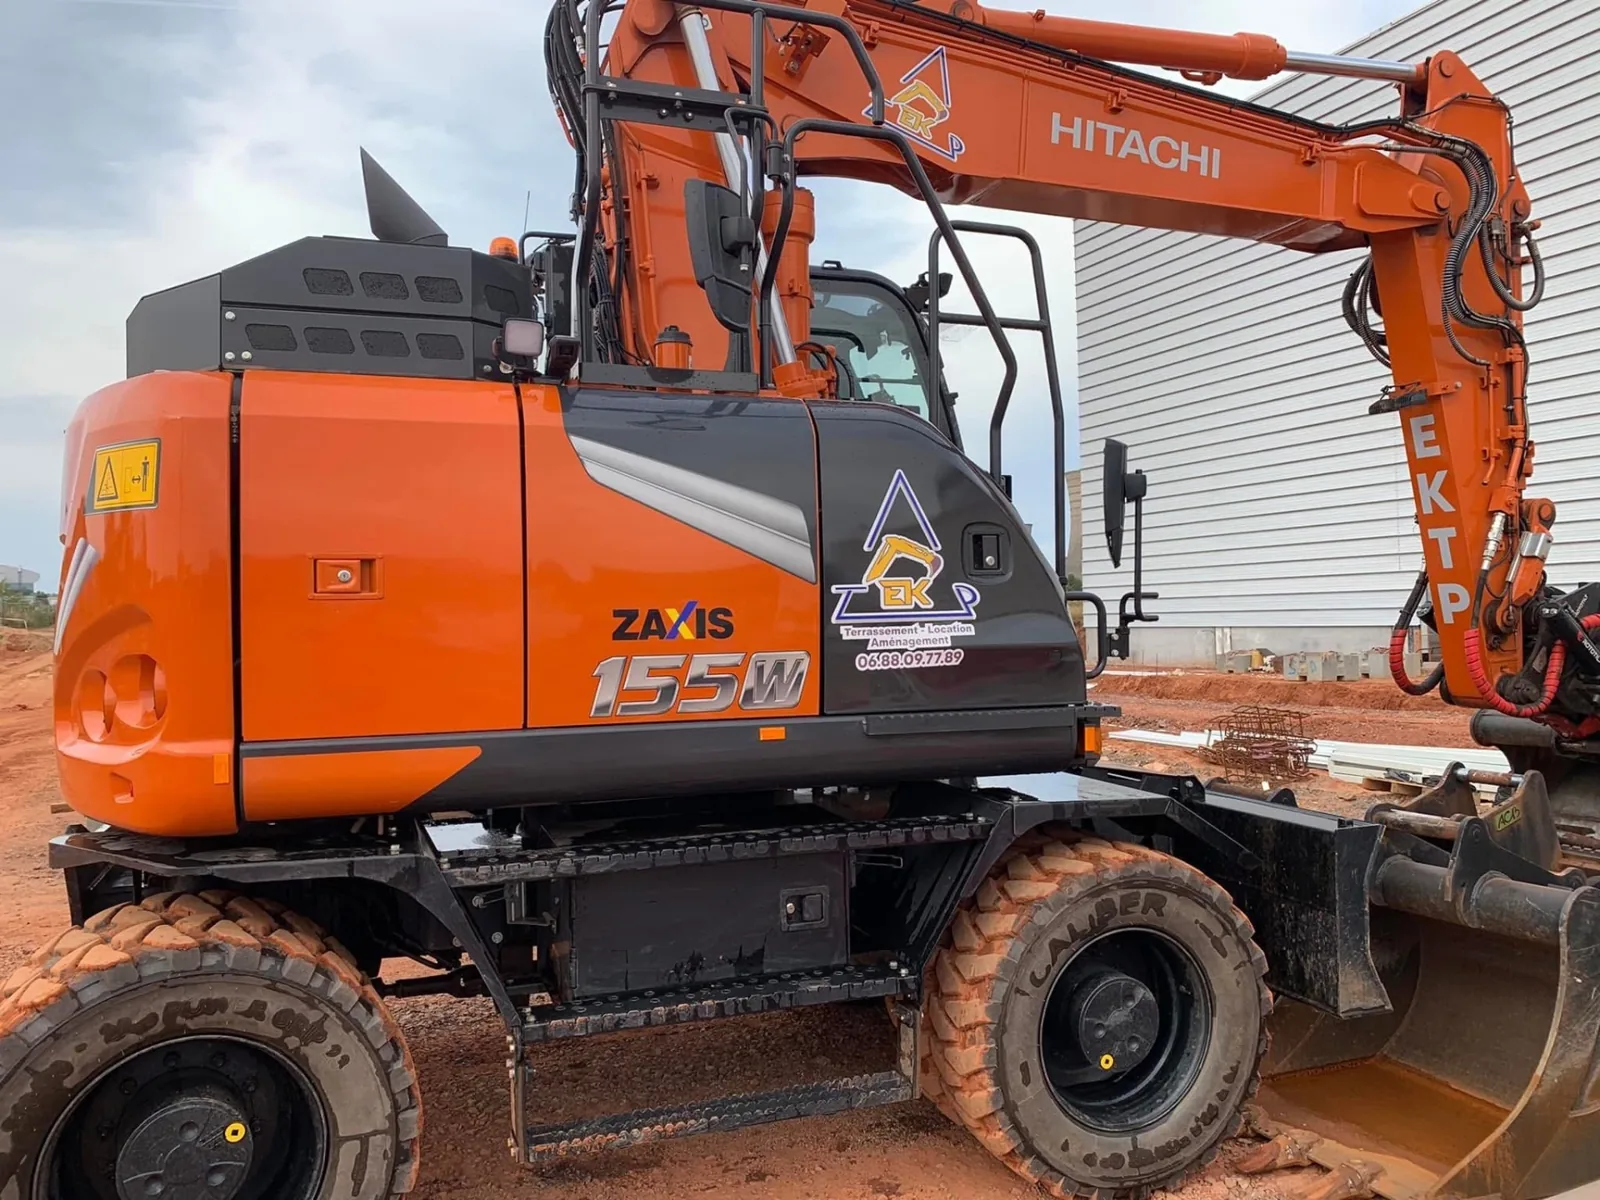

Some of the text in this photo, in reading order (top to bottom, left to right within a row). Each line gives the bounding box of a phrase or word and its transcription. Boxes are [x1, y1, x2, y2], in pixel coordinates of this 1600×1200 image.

[1050, 112, 1221, 179] HITACHI
[879, 577, 934, 609] EK
[612, 600, 735, 640] ZAXIS
[844, 626, 918, 637] Terrassement
[927, 624, 973, 634] Location
[870, 636, 950, 648] Aménagement
[857, 652, 963, 669] 06.88.09.77.89
[589, 650, 811, 718] 155W
